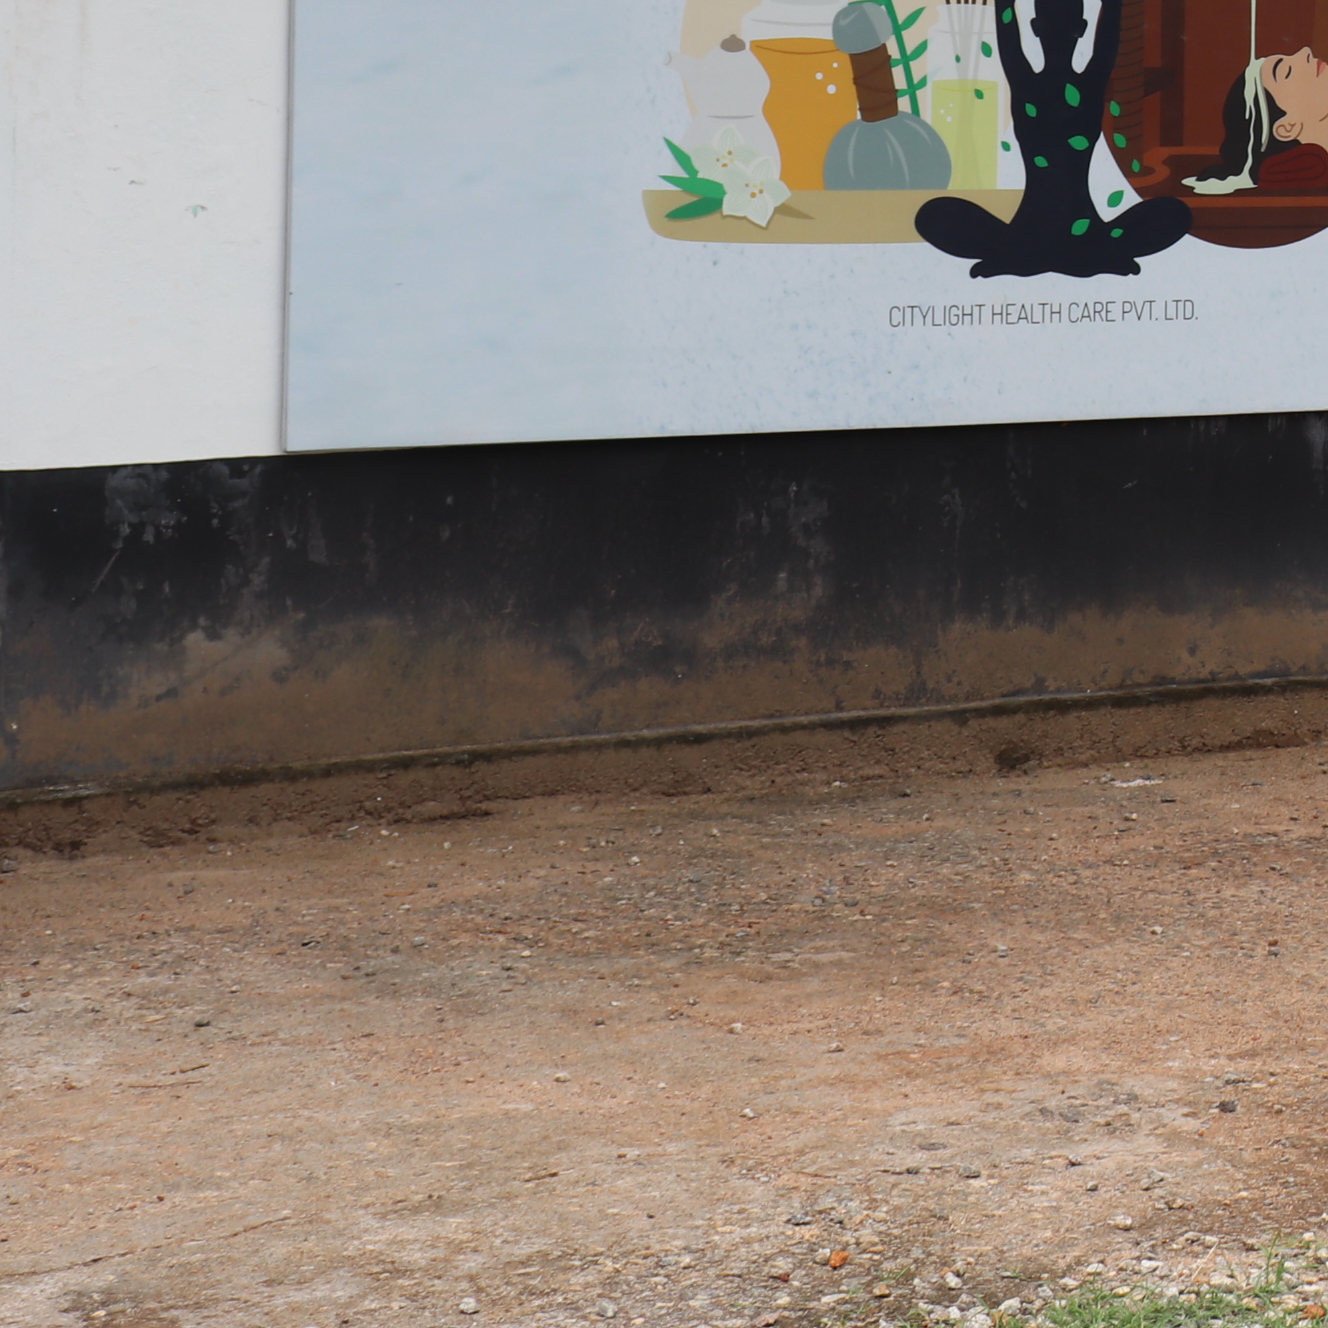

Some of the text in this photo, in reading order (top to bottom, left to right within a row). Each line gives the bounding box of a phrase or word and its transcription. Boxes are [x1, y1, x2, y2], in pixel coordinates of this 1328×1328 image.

[888, 299, 1199, 327] CITYLIGHT HEALTH CARE PVT. LTD.
